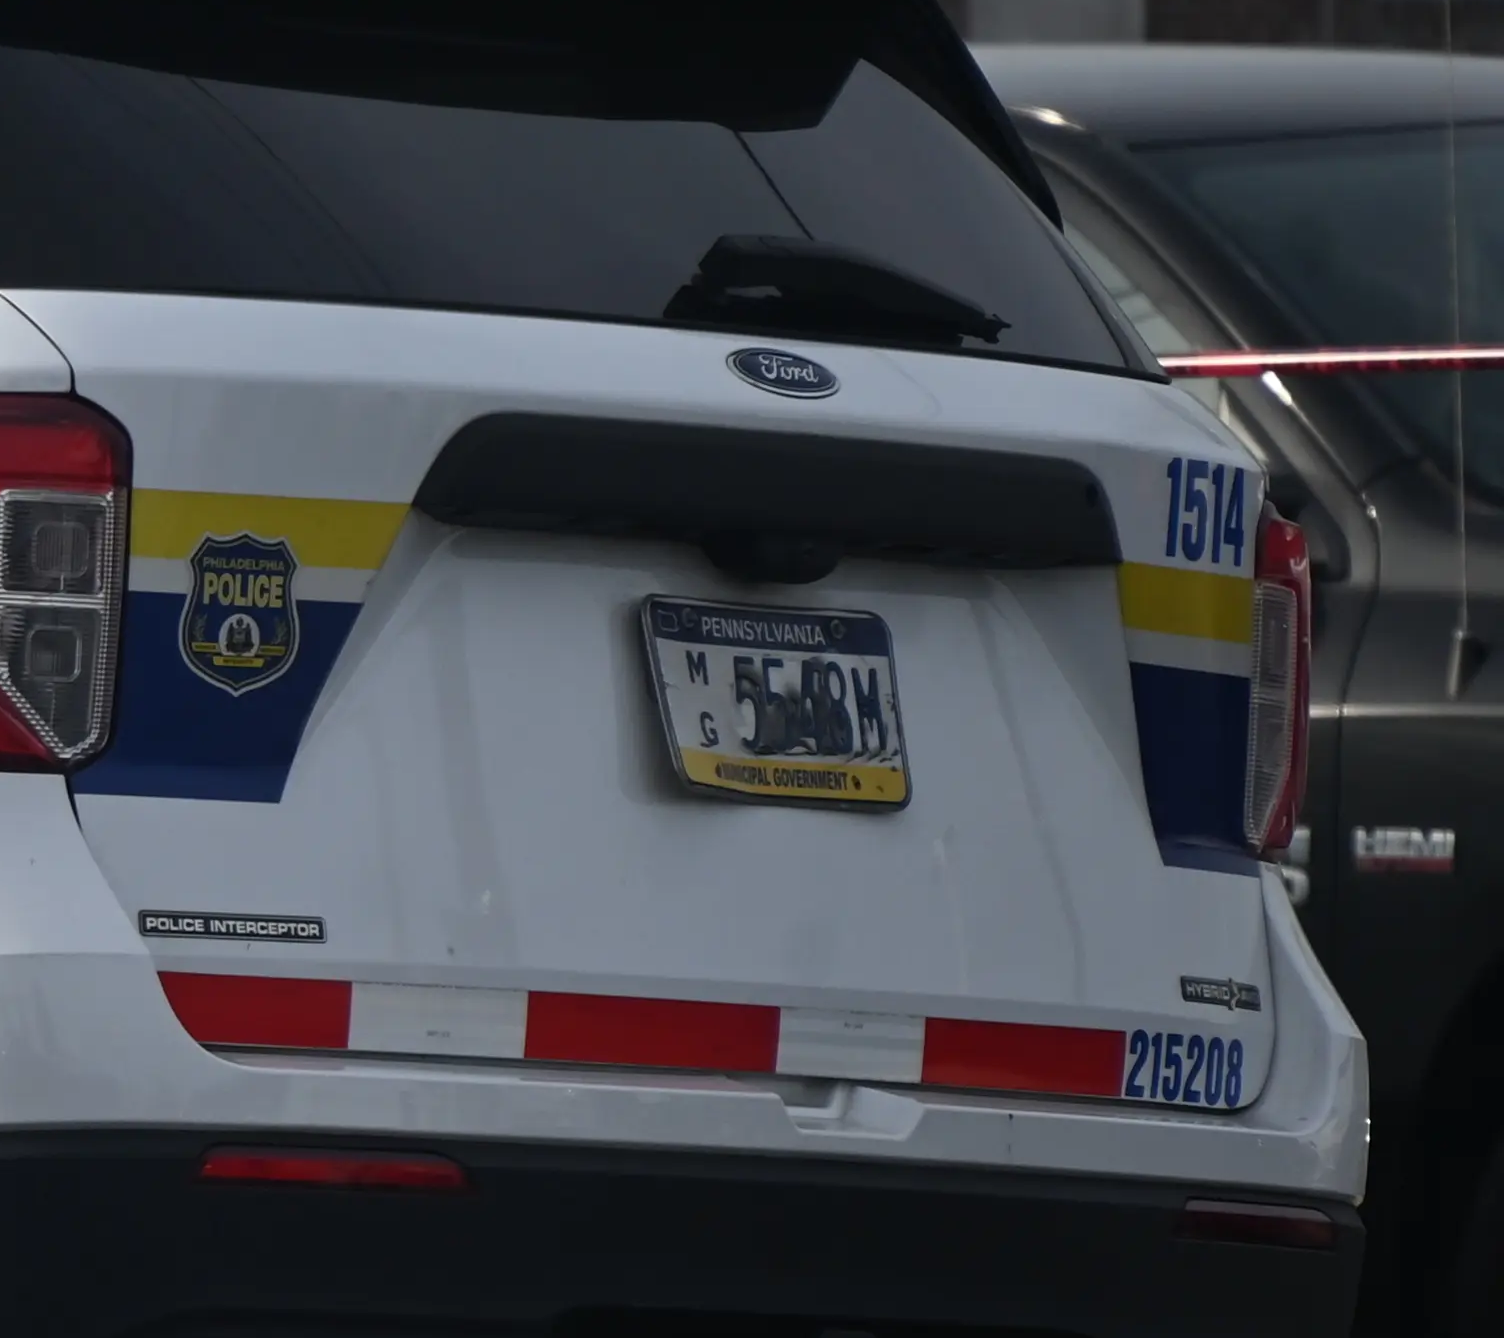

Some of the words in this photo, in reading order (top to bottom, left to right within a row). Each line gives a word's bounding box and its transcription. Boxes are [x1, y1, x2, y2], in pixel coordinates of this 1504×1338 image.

[759, 354, 819, 383] Ford
[1166, 457, 1245, 567] 1514
[202, 556, 285, 572] PHILADELPHIA
[202, 571, 285, 608] POLICE
[701, 616, 826, 646] PENNSYLVANIA
[685, 649, 709, 686] M
[699, 711, 719, 747] G
[773, 767, 848, 791] GOVERNMENT
[145, 916, 205, 932] POLICE
[209, 919, 320, 937] INTERCEPTOR
[1125, 1029, 1244, 1108] 215208
